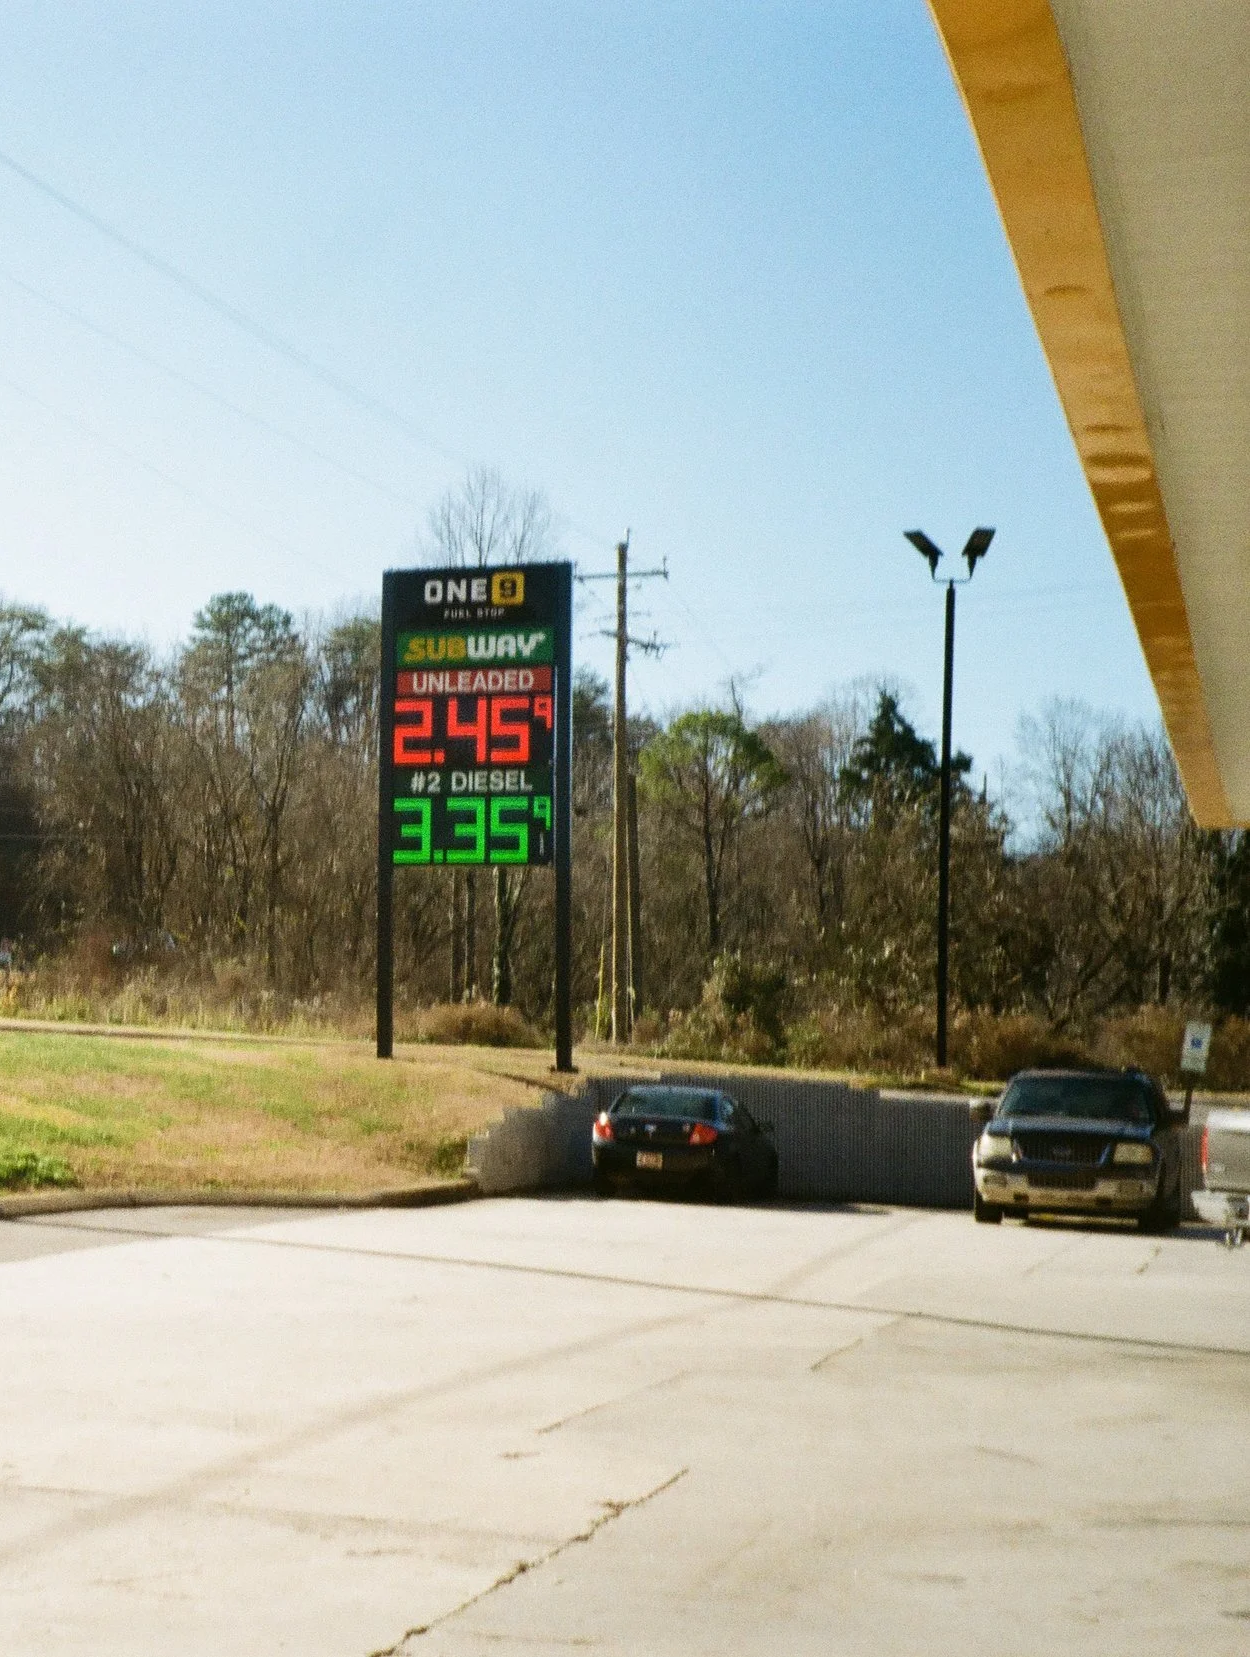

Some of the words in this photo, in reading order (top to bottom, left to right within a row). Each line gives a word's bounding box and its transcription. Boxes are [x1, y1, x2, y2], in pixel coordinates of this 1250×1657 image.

[403, 632, 546, 663] SUBWAY
[412, 669, 534, 695] UNLEADED
[410, 770, 441, 794] #2
[451, 769, 533, 793] DIESEL
